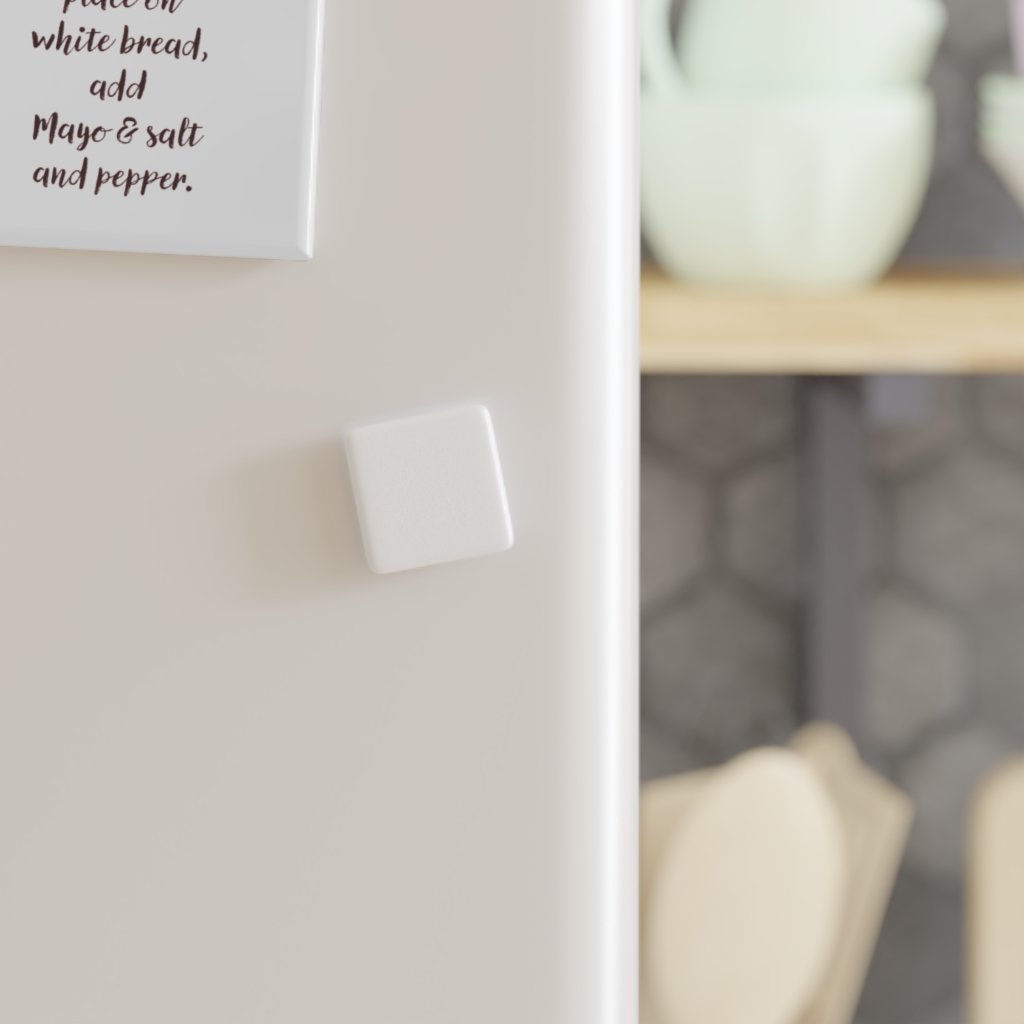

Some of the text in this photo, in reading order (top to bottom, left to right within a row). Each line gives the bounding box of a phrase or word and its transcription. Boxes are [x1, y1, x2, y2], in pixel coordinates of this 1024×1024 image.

[31, 19, 209, 63] white bread,
[89, 68, 148, 102] add
[32, 111, 205, 152] Mayo & salt
[32, 156, 193, 198] and pepper.
